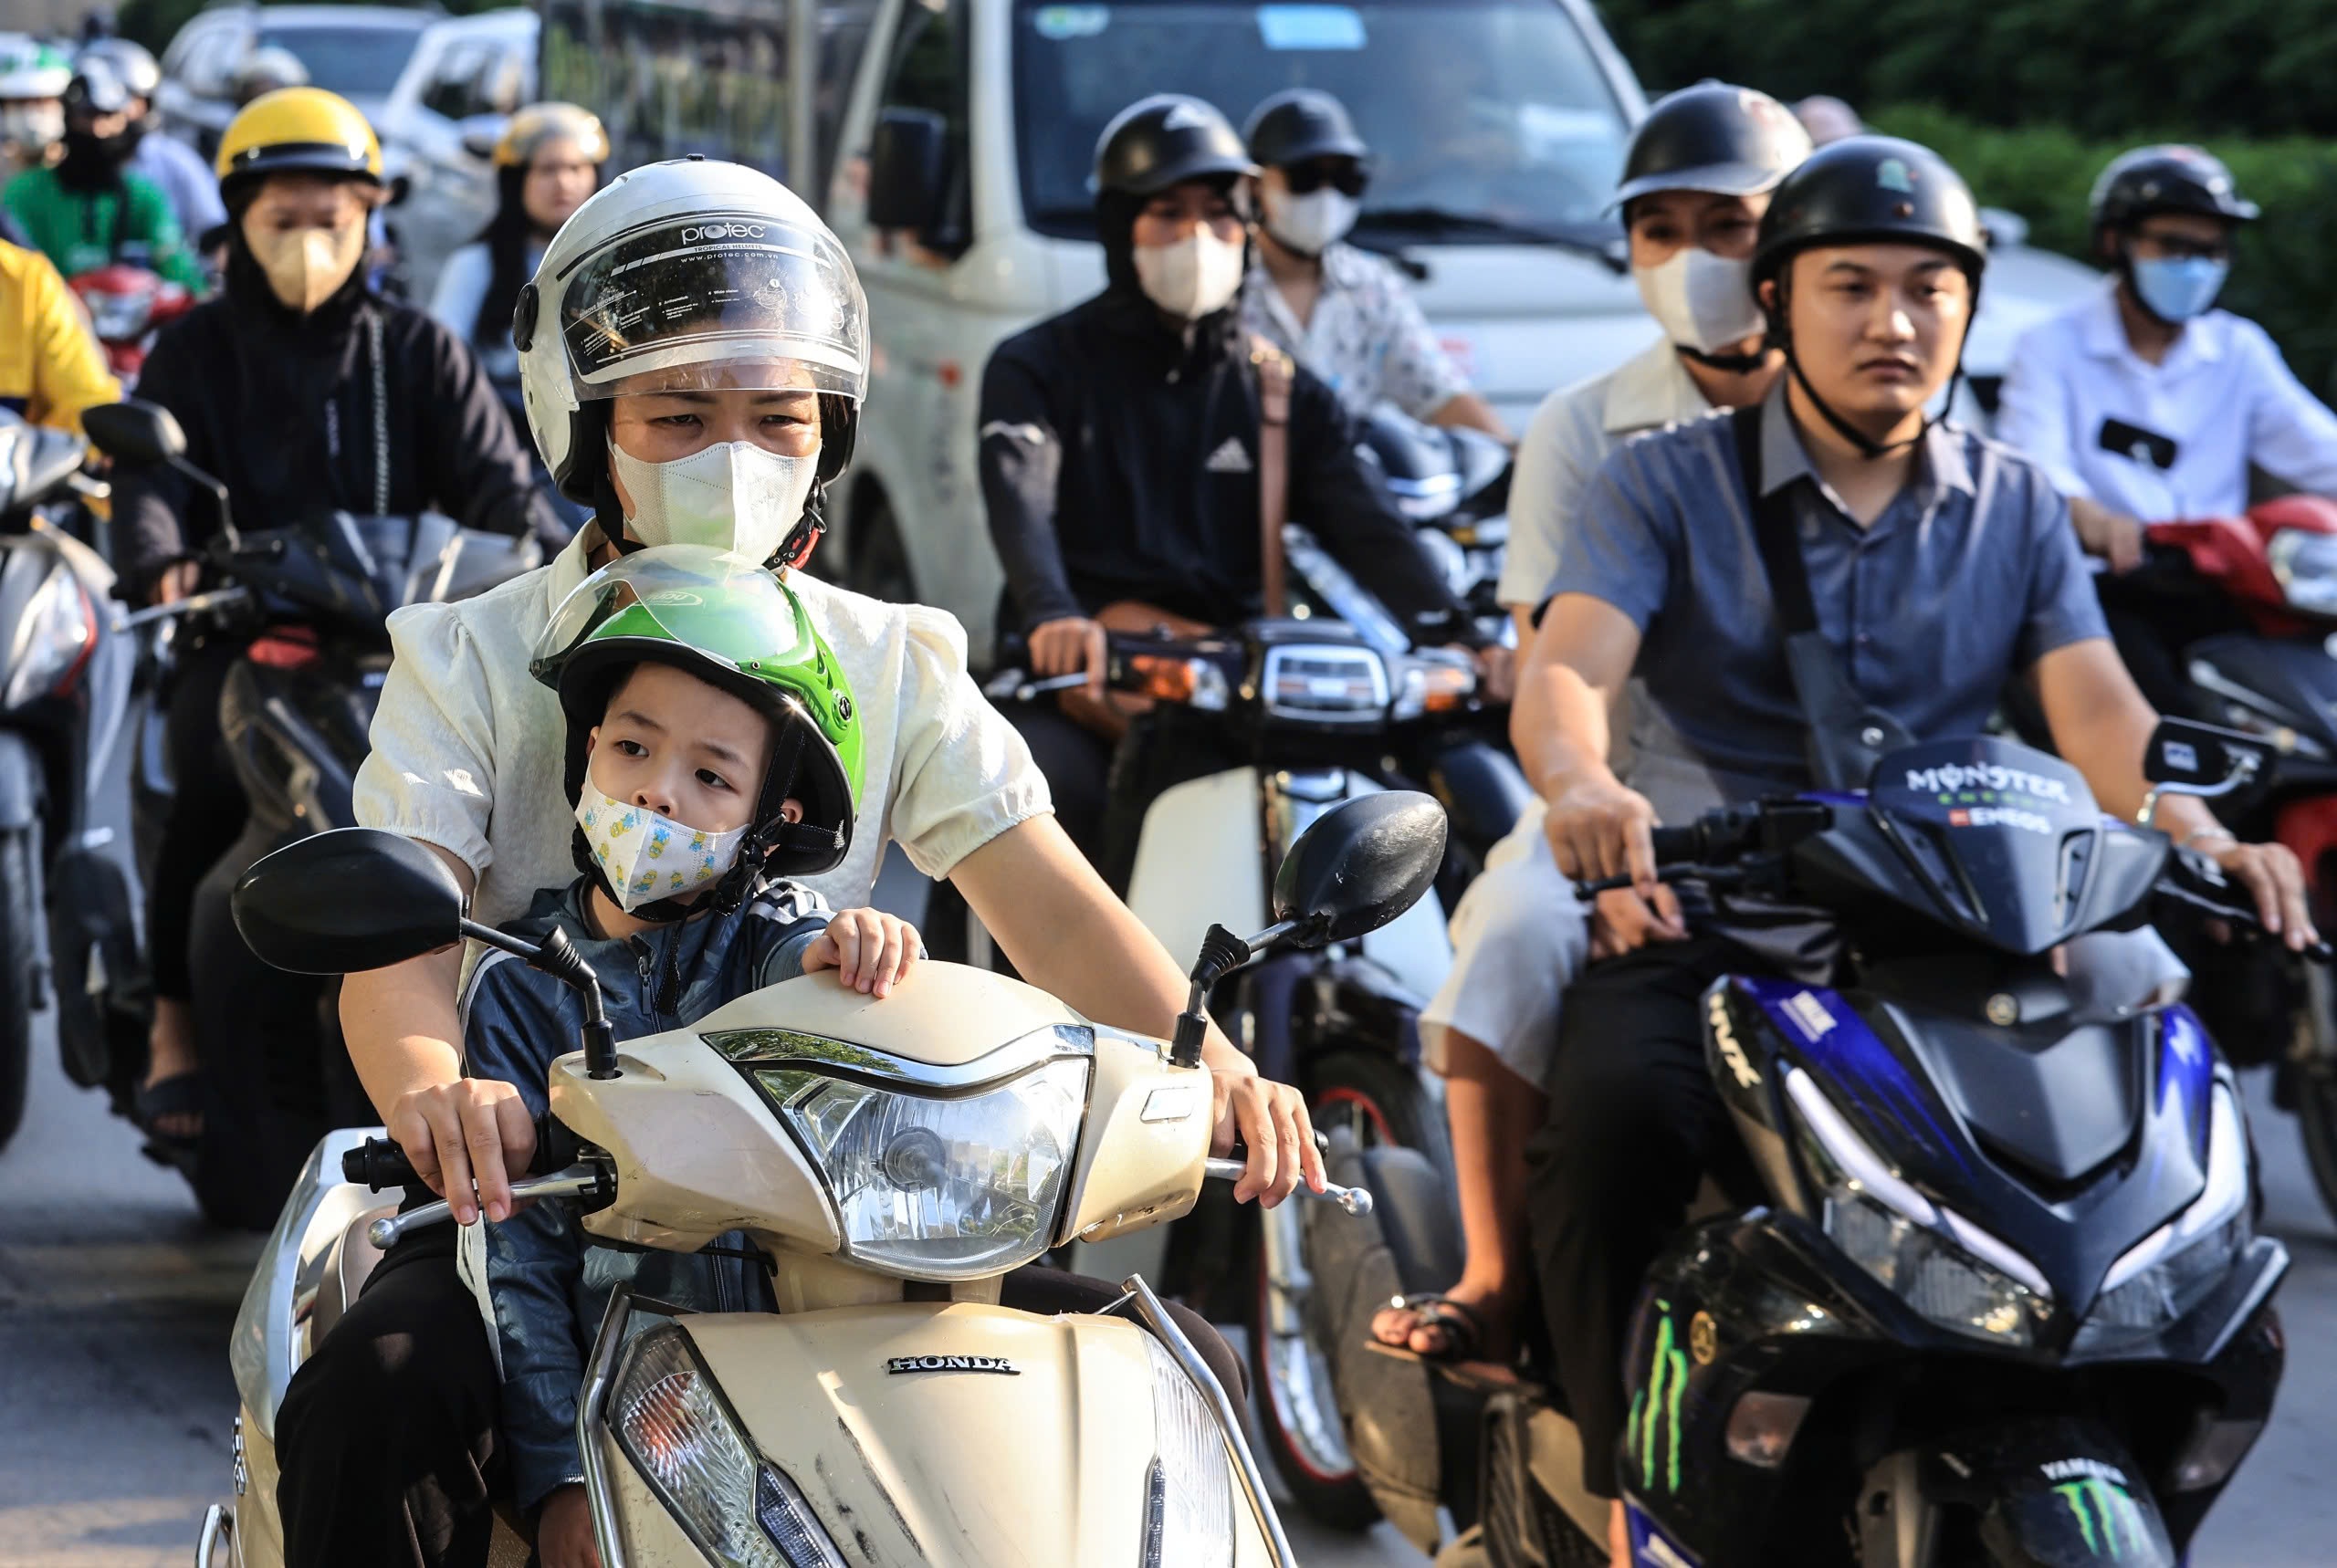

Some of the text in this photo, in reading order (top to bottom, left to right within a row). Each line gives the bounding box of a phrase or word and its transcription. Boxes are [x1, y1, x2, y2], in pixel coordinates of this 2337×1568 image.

[681, 223, 765, 245] protec
[680, 252, 779, 263] www.protec.com.vn
[695, 245, 730, 253] TROPICAL
[1905, 760, 2072, 804] MONSTER
[889, 1354, 1019, 1373] HONDA
